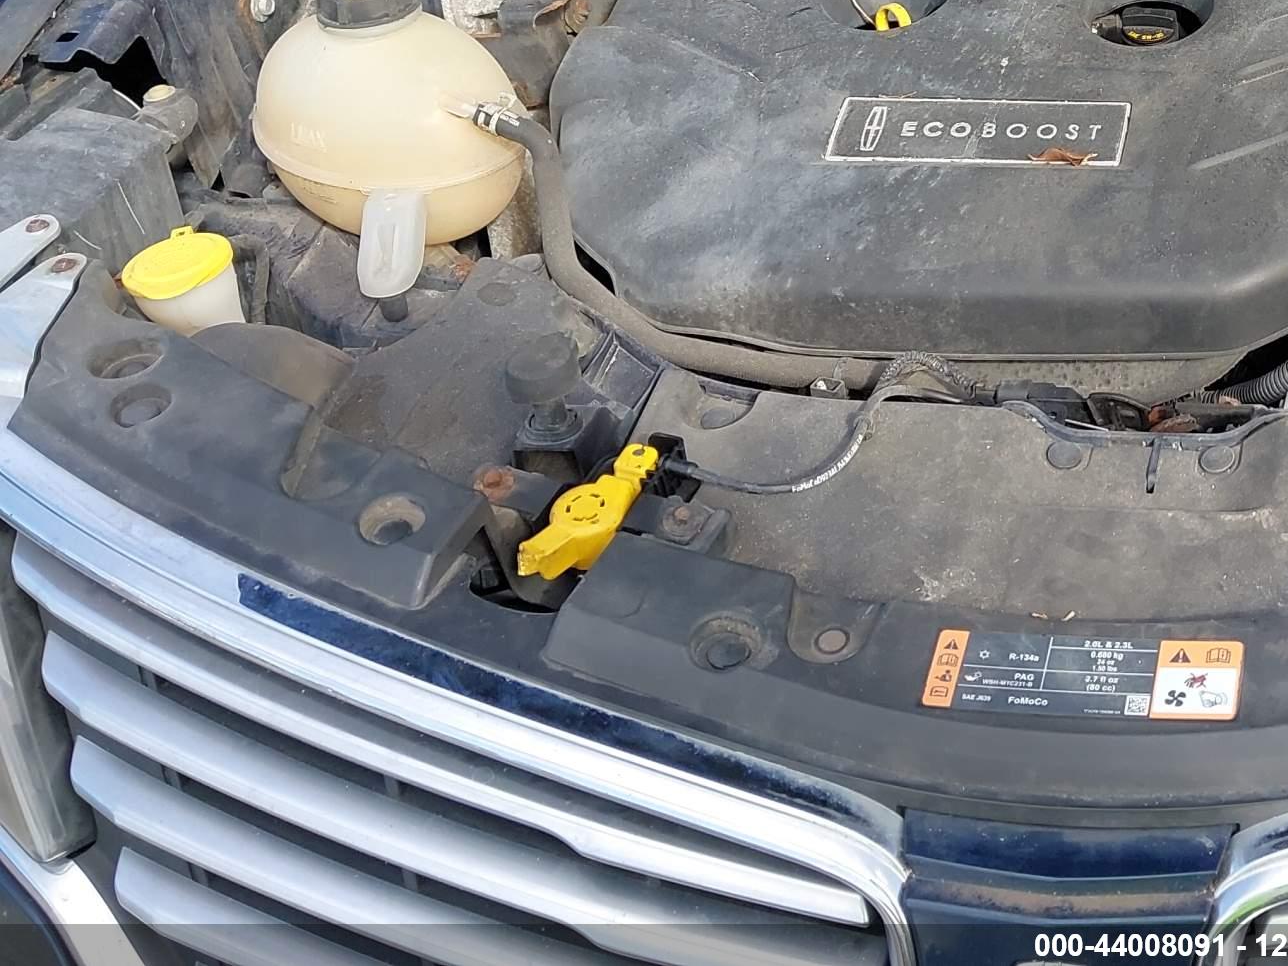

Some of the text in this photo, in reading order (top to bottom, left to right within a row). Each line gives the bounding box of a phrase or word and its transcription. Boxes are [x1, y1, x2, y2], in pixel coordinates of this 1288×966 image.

[900, 120, 1102, 141] ECOBOOST
[1008, 652, 1040, 662] R-134a
[1014, 672, 1035, 681] PAG
[961, 693, 976, 701] SAE
[1008, 696, 1049, 706] FoMoCo
